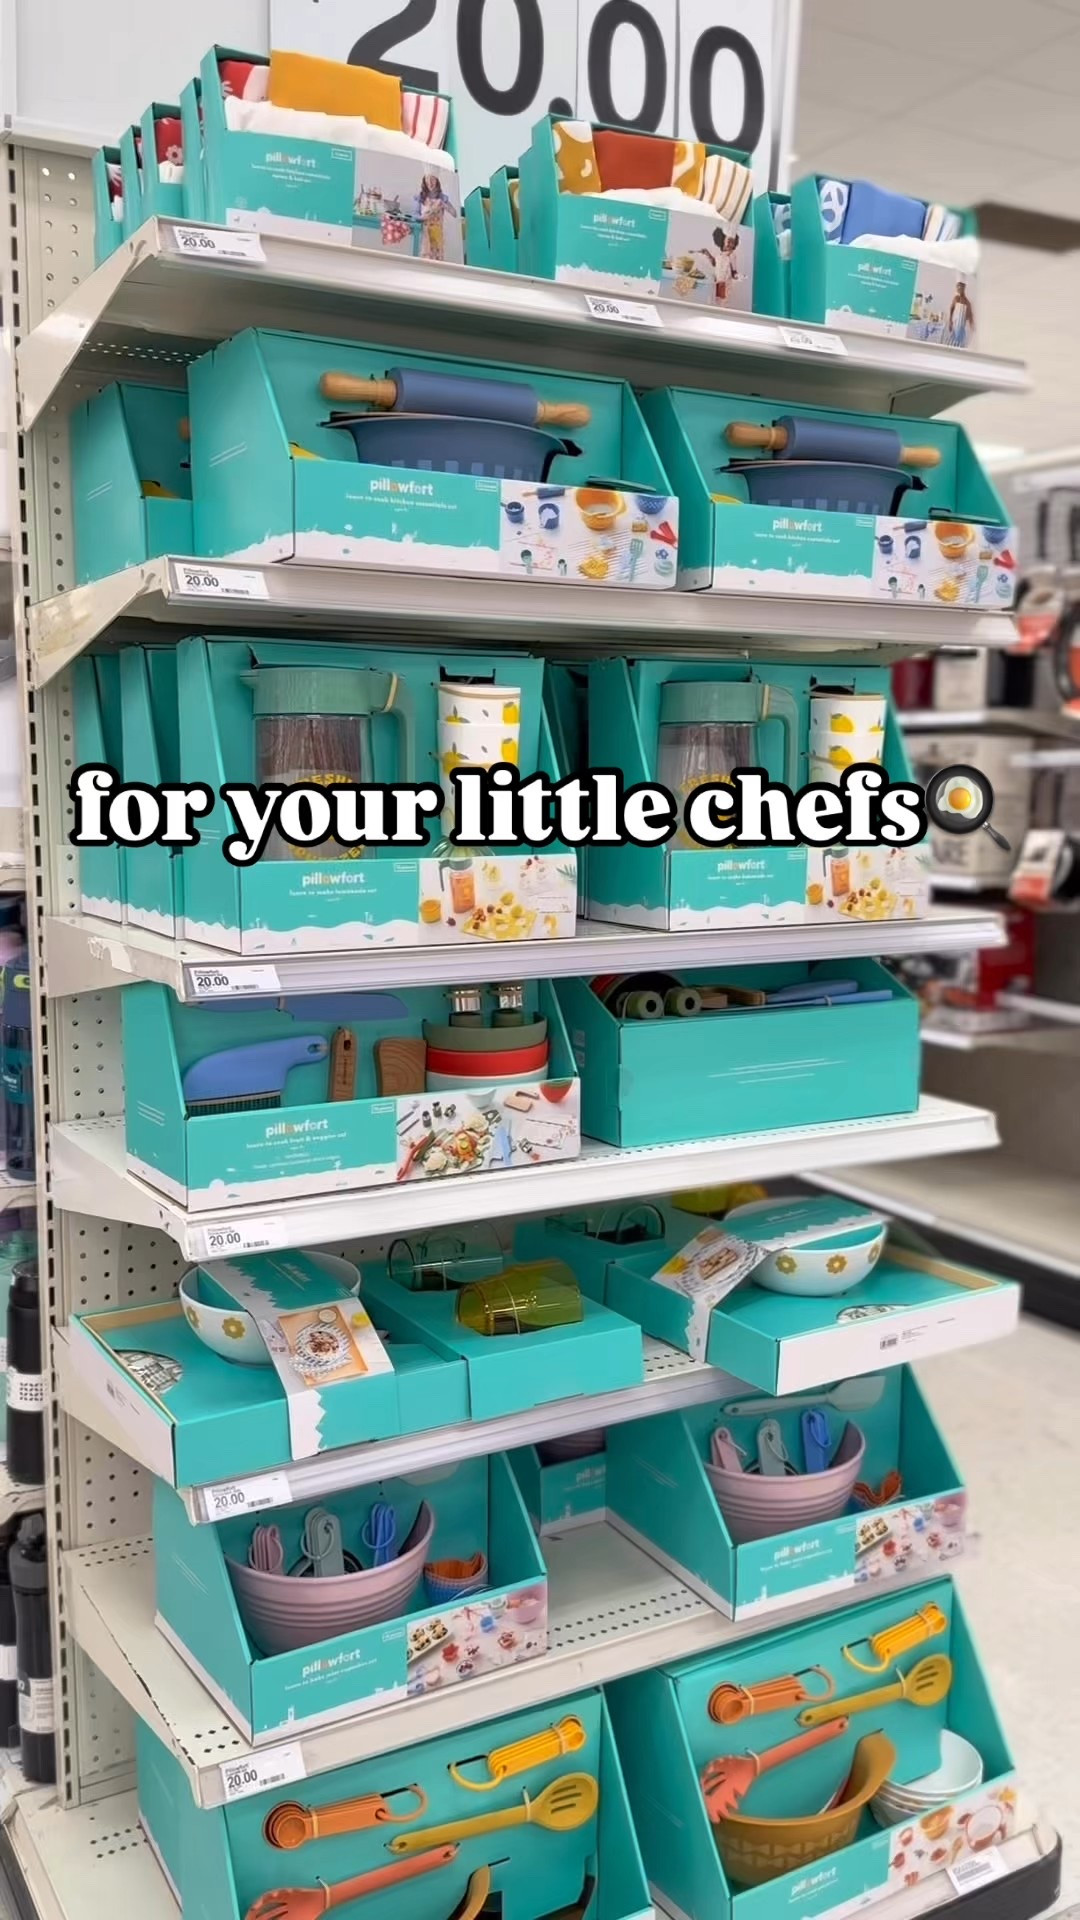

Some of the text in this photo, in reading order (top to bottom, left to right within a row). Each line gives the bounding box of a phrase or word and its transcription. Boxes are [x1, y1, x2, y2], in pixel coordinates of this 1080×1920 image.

[181, 235, 216, 249] 20.00
[370, 477, 434, 496] pillowfort
[773, 517, 822, 532] pillowfort
[185, 575, 219, 587] 20.00
[717, 859, 766, 873] pillowfort
[302, 872, 365, 887] pillowfort
[196, 975, 229, 987] 20.00
[265, 1119, 328, 1139] pillowfort
[209, 1232, 241, 1246] 20.00
[214, 1491, 245, 1508] 20.00
[302, 1648, 361, 1678] pillowfort
[227, 1769, 258, 1789] 20.00
